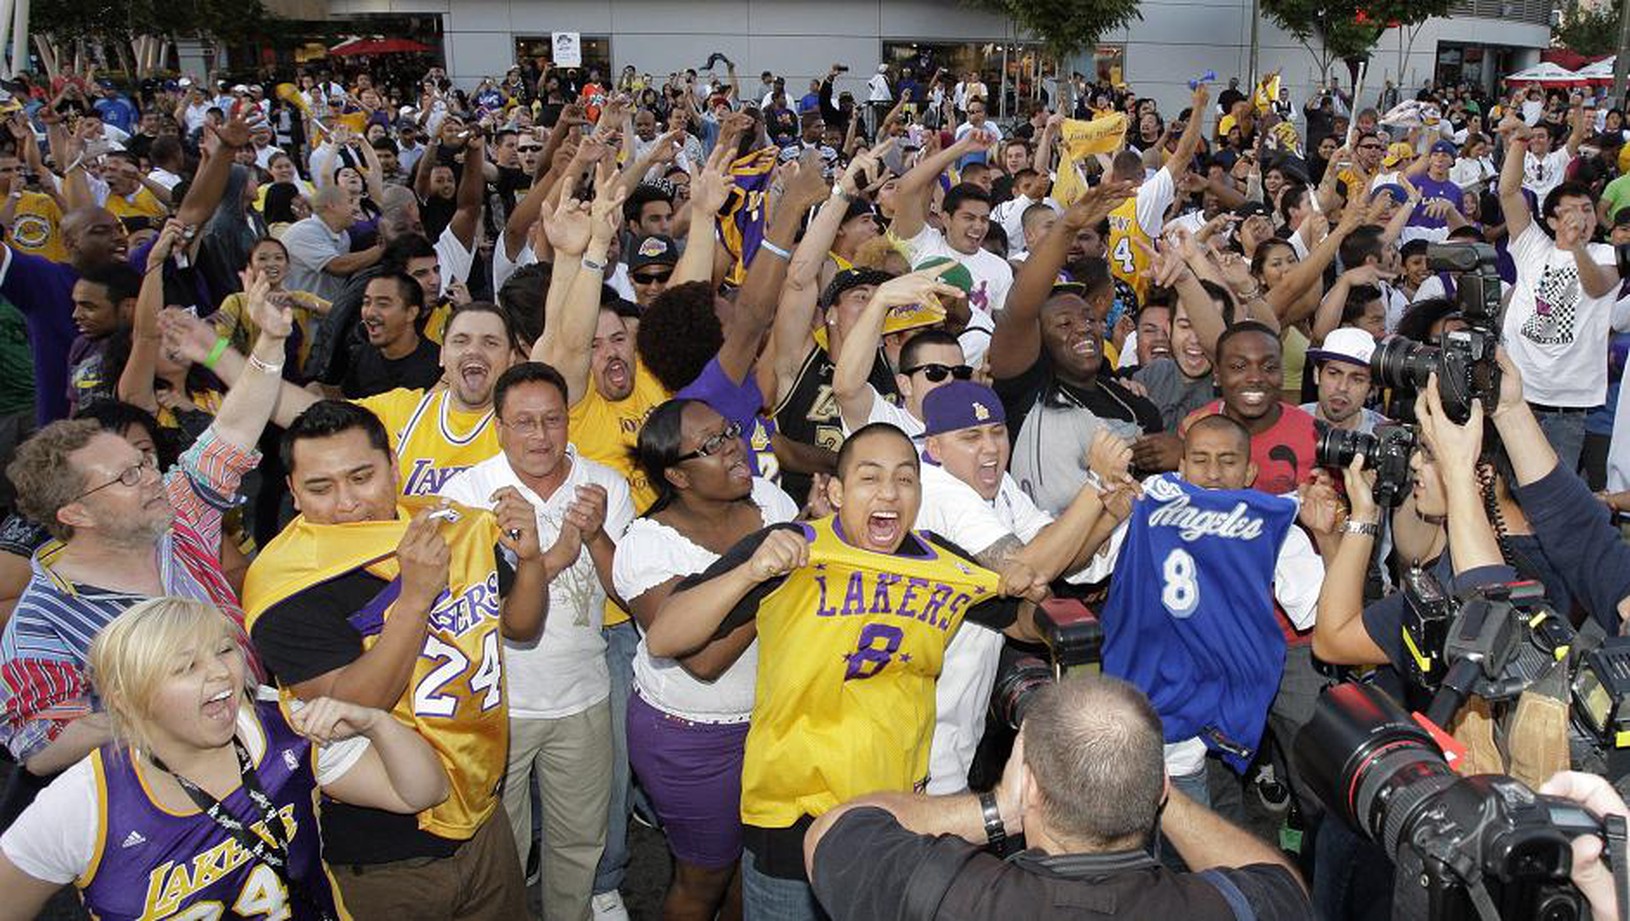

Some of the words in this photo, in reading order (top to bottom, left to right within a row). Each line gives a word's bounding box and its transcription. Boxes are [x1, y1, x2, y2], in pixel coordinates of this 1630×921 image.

[1149, 494, 1264, 542] Angeles
[814, 571, 972, 631] LAKERS
[1161, 548, 1200, 619] 8
[414, 628, 502, 717] 24
[844, 623, 904, 681] 8
